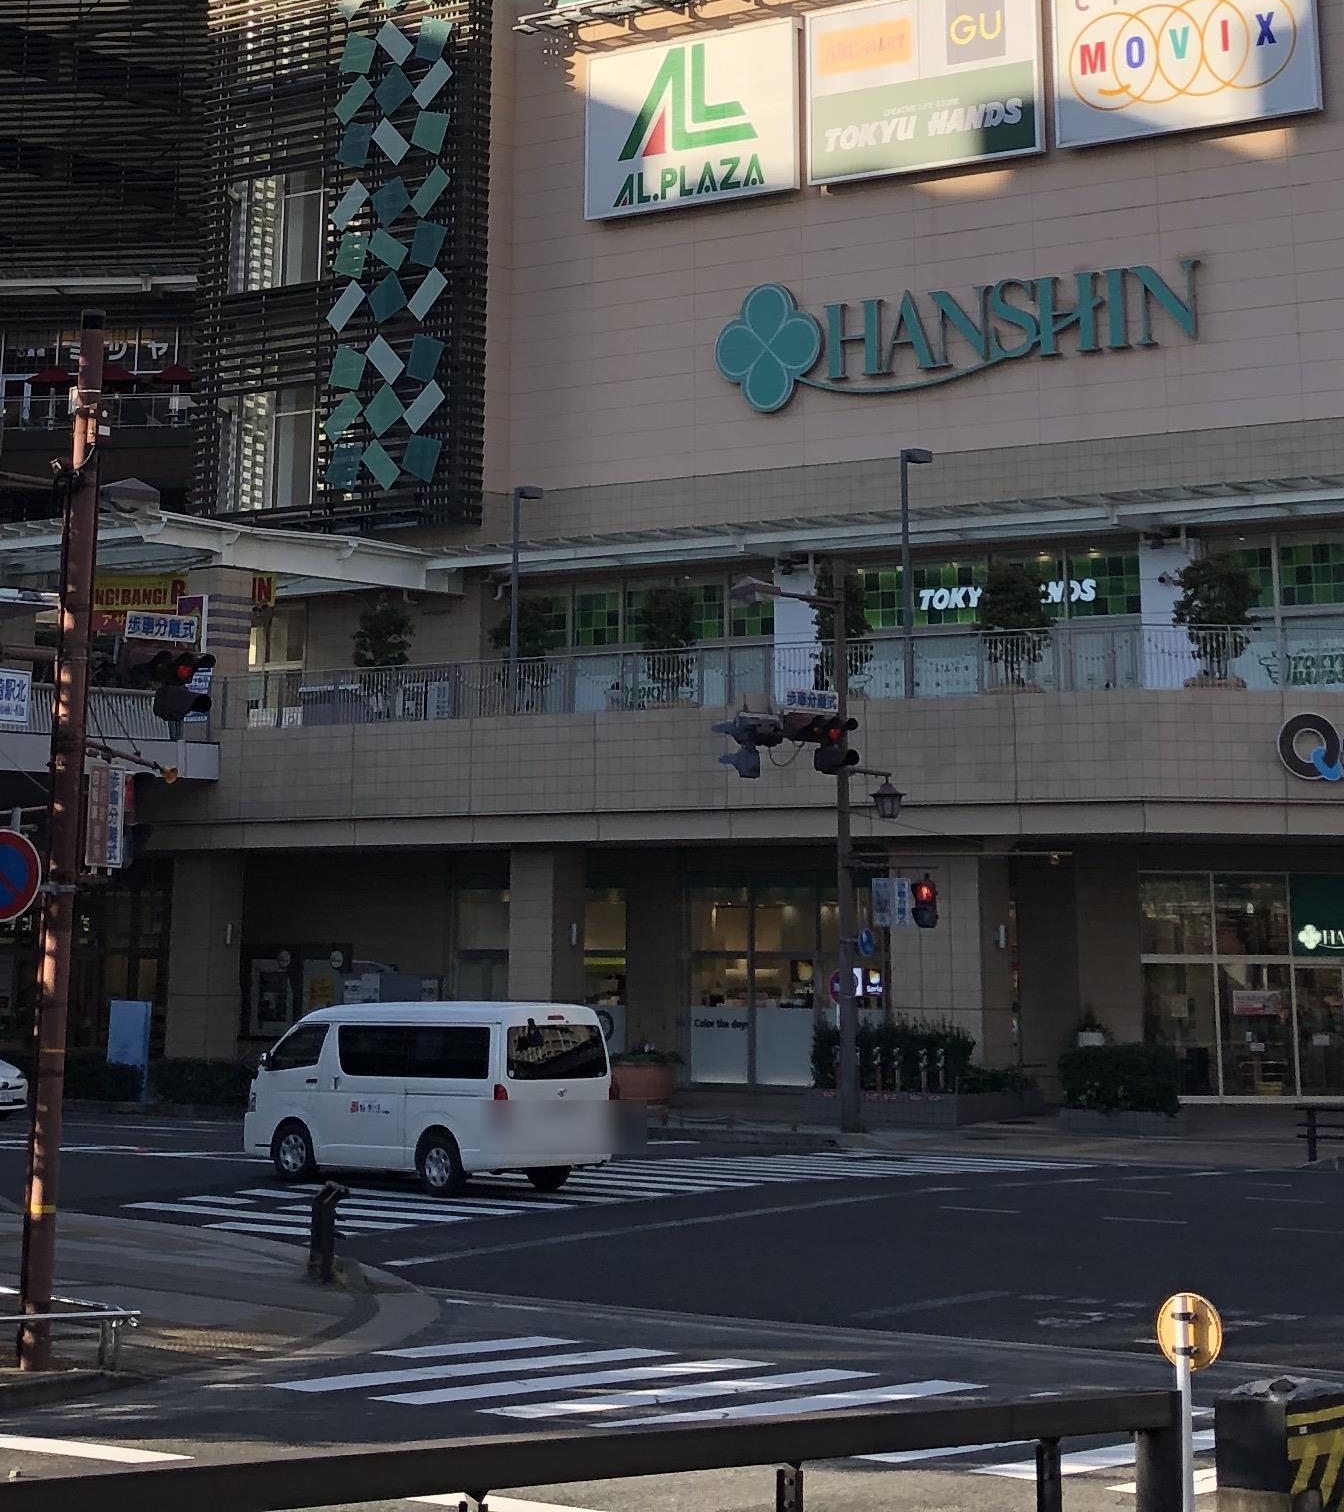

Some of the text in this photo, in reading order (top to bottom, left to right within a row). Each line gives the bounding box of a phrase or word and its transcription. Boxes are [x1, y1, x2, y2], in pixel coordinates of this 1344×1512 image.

[950, 9, 1002, 45] GU
[1079, 11, 1278, 76] MOVIX
[824, 97, 1023, 153] TOKYU HANDS
[613, 153, 765, 208] AL.PLAZA
[824, 259, 1202, 380] HANSHIN
[919, 586, 982, 610] TOKY
[128, 616, 195, 639] 歩車分離式
